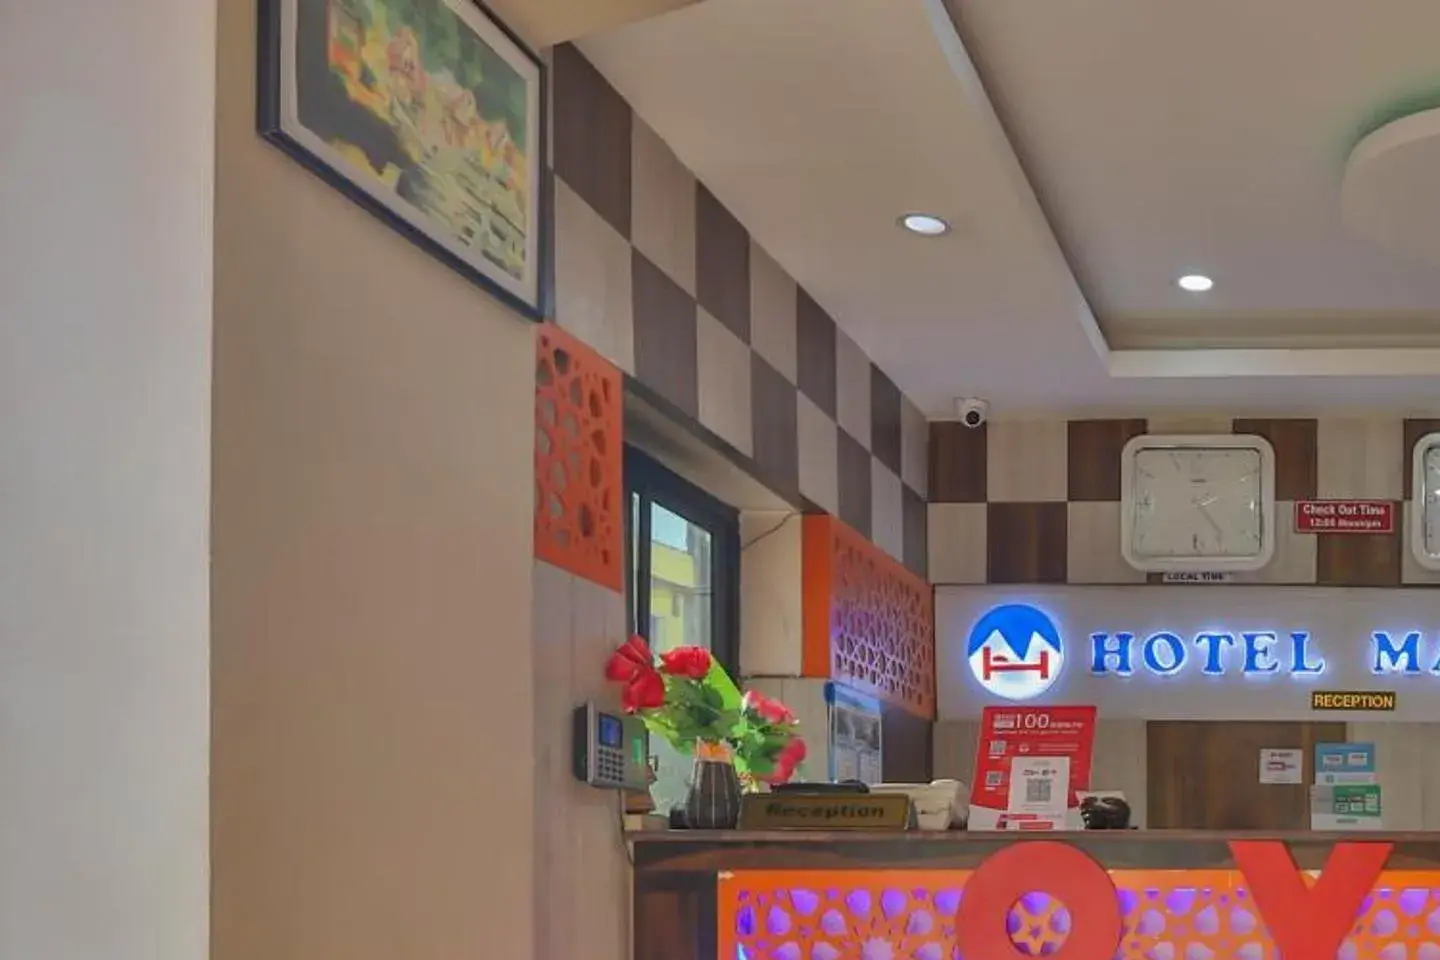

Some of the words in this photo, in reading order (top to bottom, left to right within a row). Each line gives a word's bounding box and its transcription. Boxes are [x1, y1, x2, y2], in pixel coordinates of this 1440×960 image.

[1303, 503, 1336, 515] Check
[1338, 504, 1357, 516] Out
[1359, 504, 1386, 516] Time
[1090, 631, 1325, 674] HOTEL
[1314, 693, 1394, 708] RECEPTION
[765, 803, 885, 819] Reception
